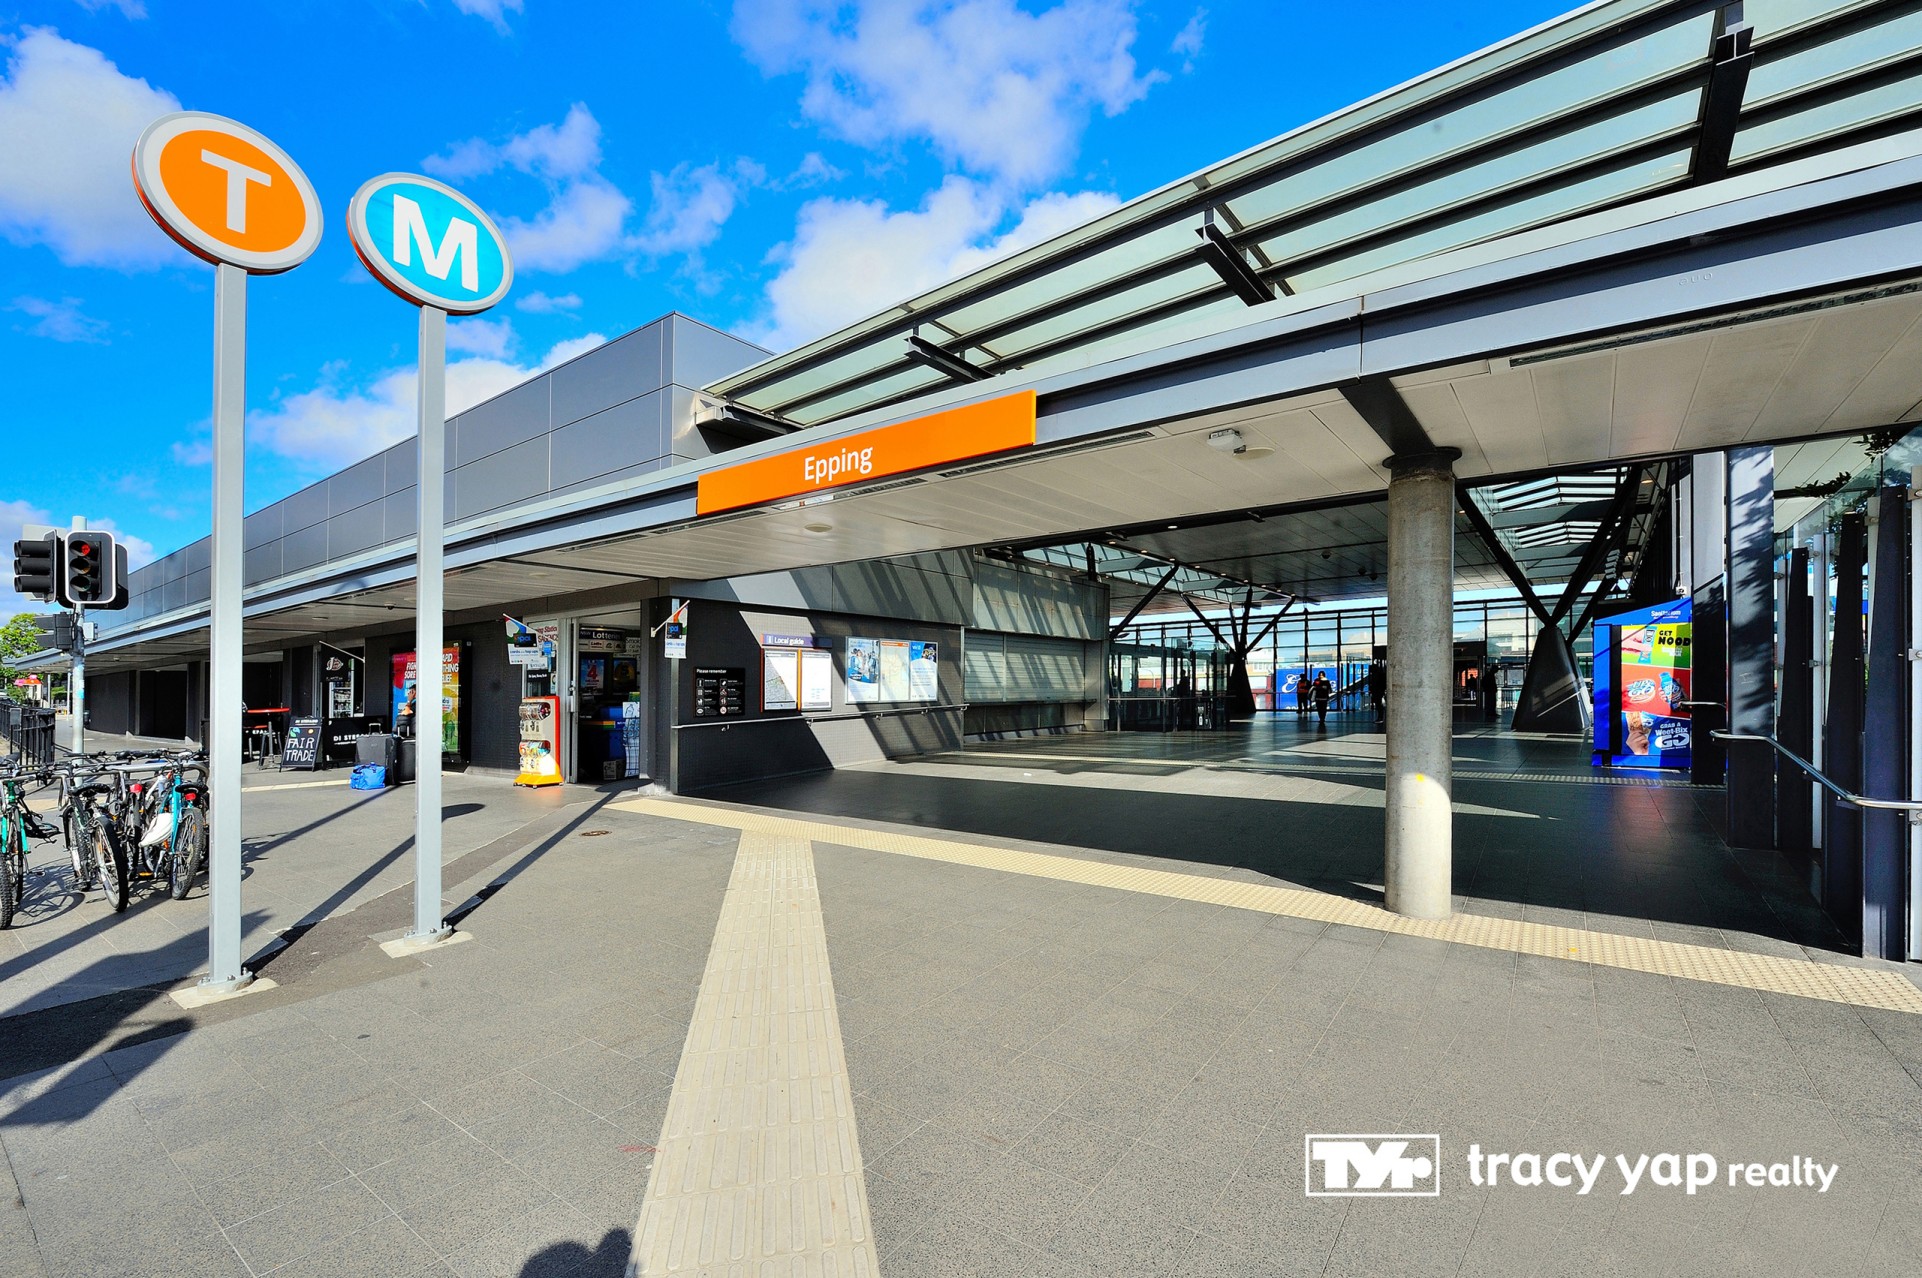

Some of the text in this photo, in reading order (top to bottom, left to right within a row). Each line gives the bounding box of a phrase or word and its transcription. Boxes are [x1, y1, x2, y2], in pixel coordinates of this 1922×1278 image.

[201, 148, 272, 234] T
[393, 193, 479, 293] M
[803, 446, 874, 484] Epping
[774, 637, 805, 646] Local guide
[1654, 727, 1688, 736] Weet-Bix
[287, 737, 315, 749] FAIR
[286, 750, 316, 762] TRADE
